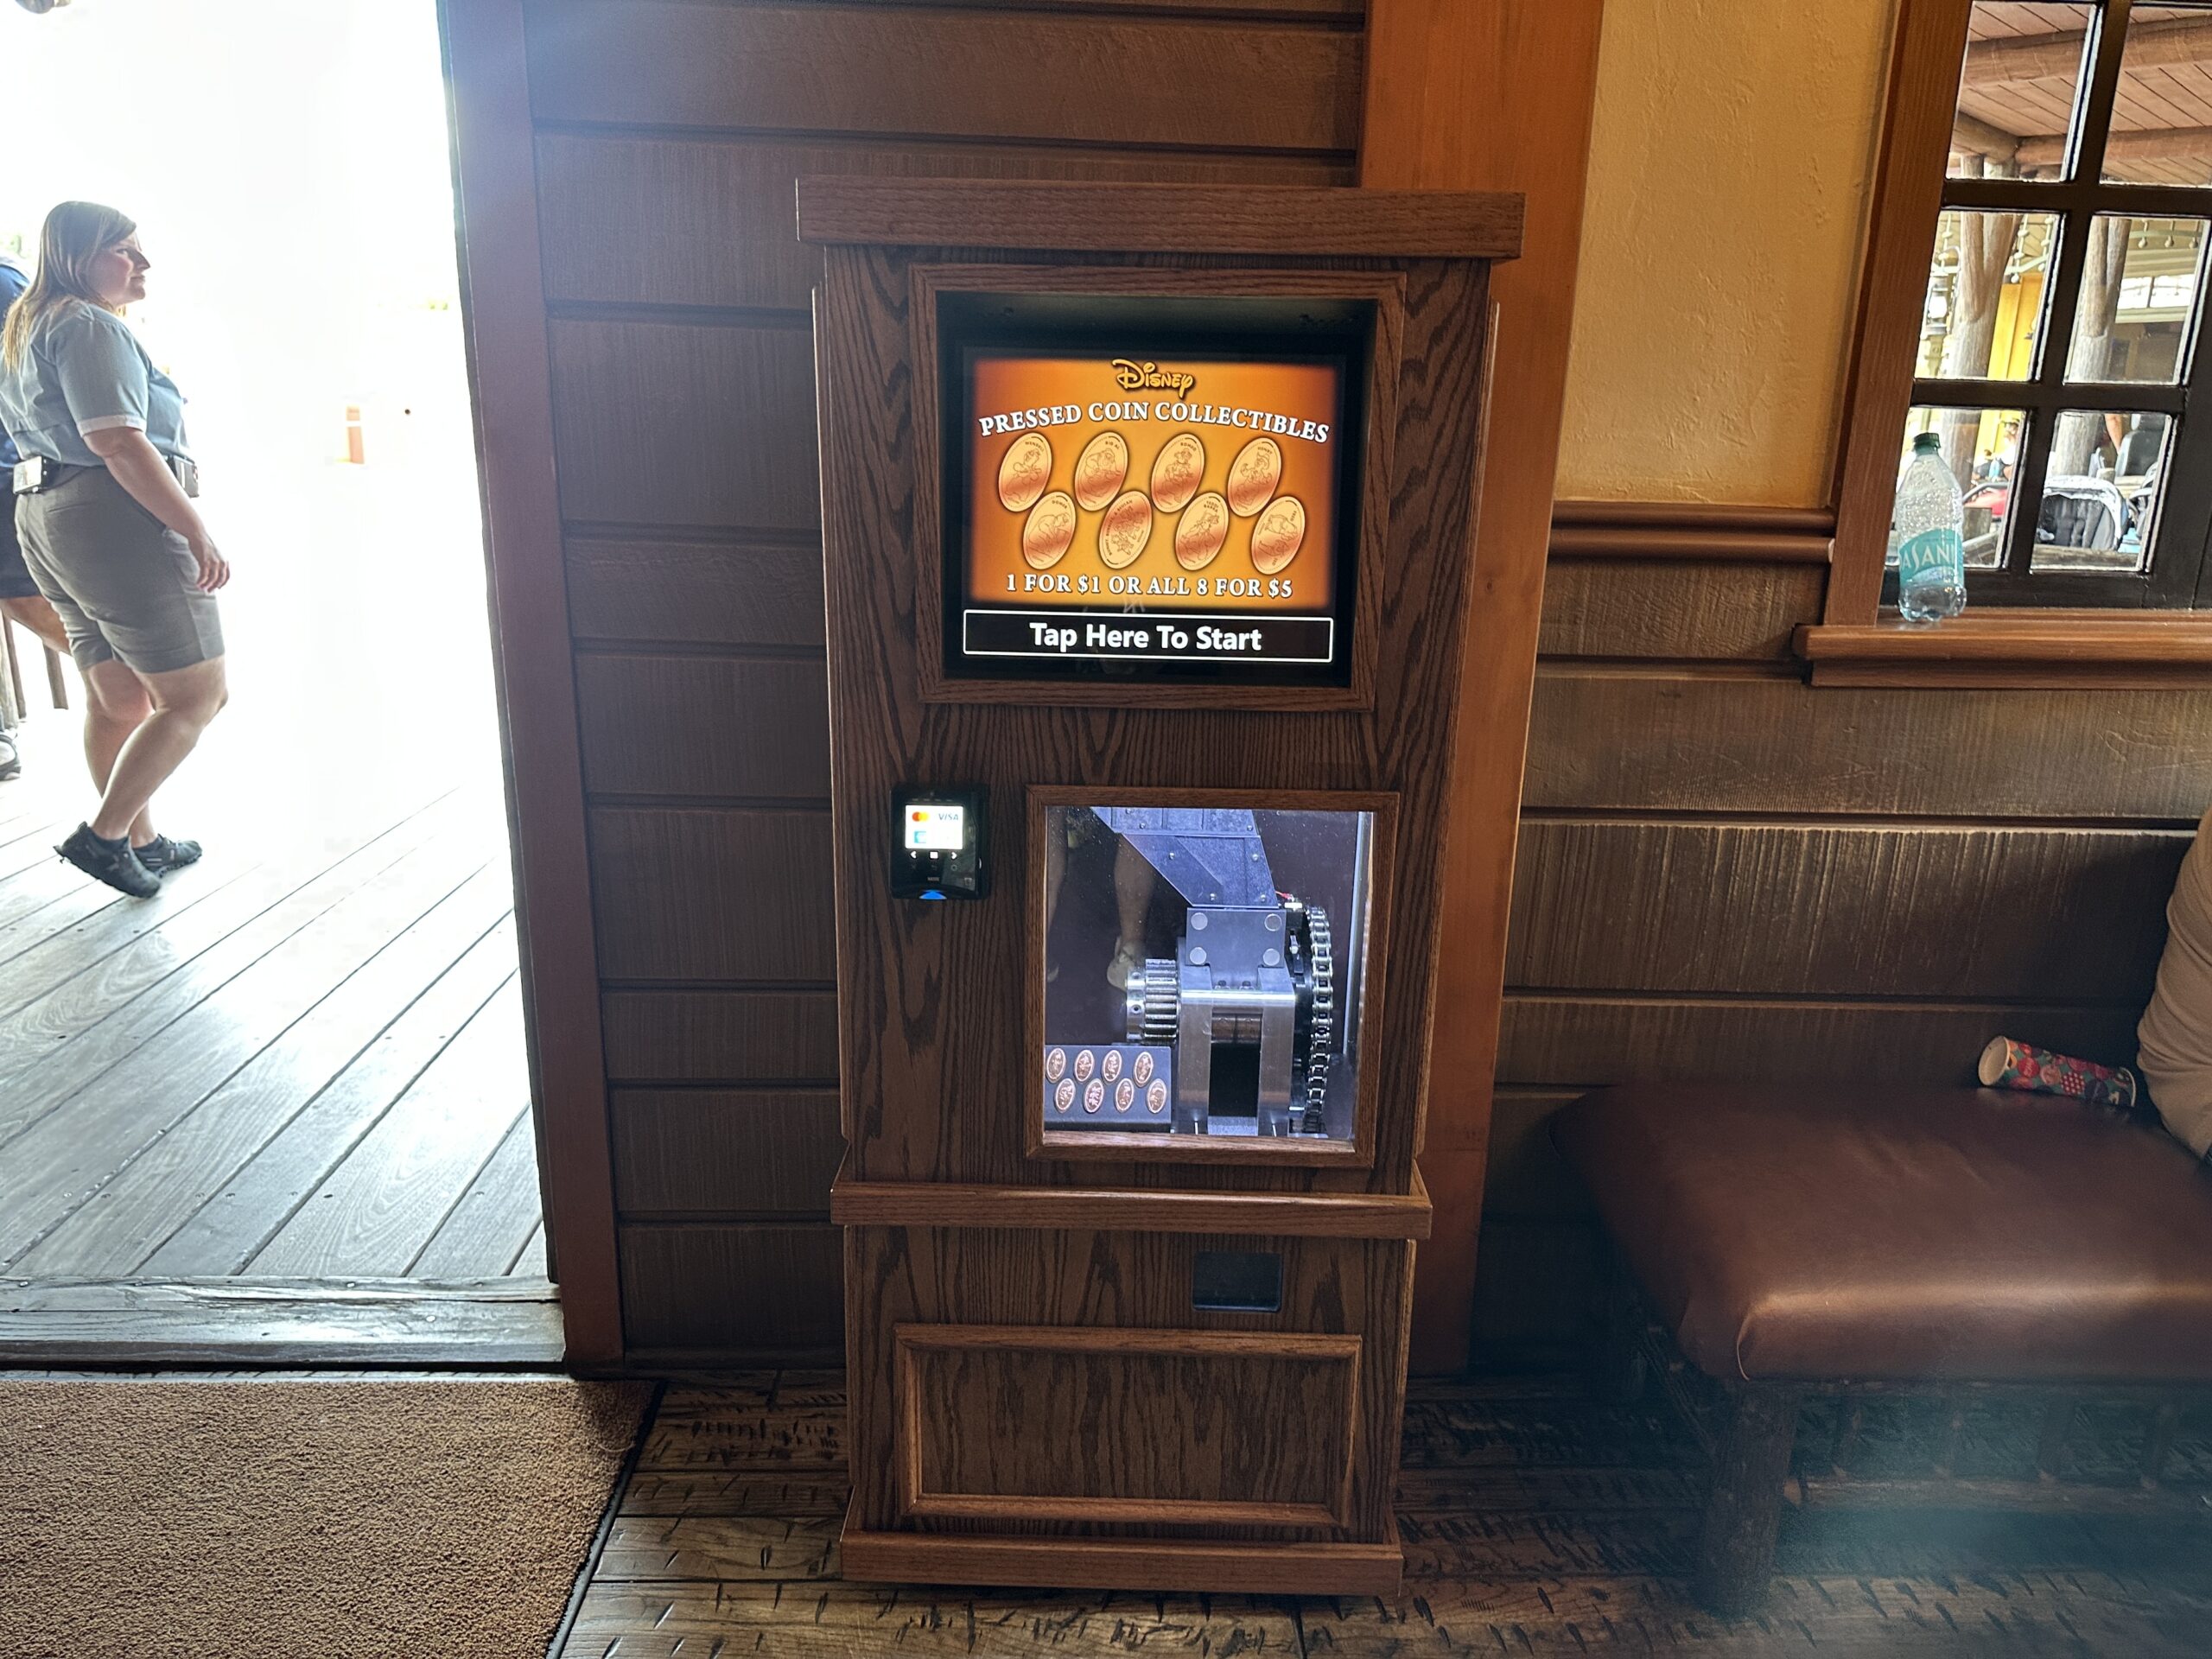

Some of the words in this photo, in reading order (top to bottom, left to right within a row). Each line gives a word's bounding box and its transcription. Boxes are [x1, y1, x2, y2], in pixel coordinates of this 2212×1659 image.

[1111, 358, 1194, 398] Disney
[977, 404, 1082, 437] PRESSED
[1088, 401, 1150, 422] COIN
[1154, 401, 1331, 444] COLLECTIBLES
[1007, 573, 1017, 592] 1
[1024, 574, 1071, 593] FOR
[1077, 574, 1101, 594] $1
[1109, 575, 1142, 594] OR
[1147, 576, 1191, 595] ALL
[1197, 578, 1208, 596] 8
[1215, 577, 1262, 597] FOR
[1268, 578, 1293, 599] $5
[1029, 622, 1077, 653] Tap
[1086, 623, 1149, 648] Here
[1156, 625, 1189, 650] To
[1196, 626, 1262, 651] Start
[938, 812, 959, 821] VISA
